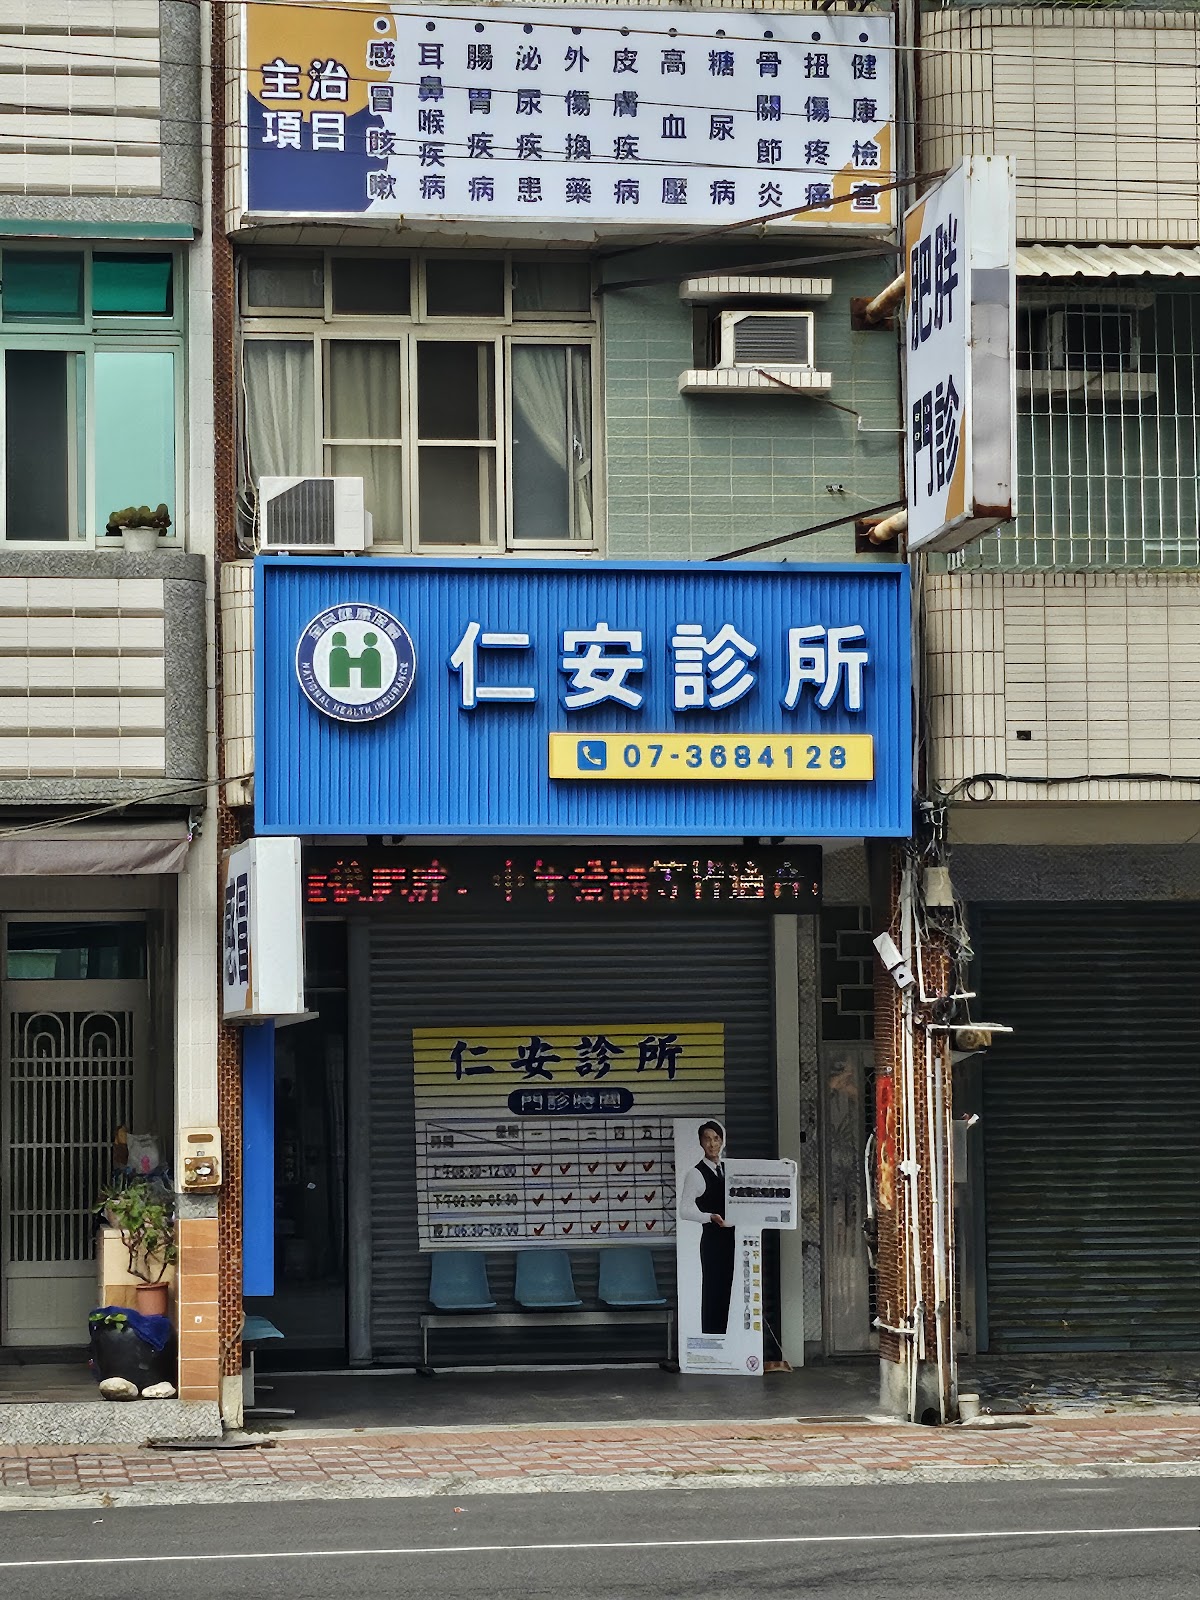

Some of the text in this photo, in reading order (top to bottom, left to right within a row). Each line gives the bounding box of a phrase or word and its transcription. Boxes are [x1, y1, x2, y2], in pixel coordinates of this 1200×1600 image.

[261, 58, 349, 101] 主治
[261, 111, 346, 151] 項目
[369, 41, 397, 200] 感冒咳嗽
[418, 42, 446, 200] 耳鼻喉疾病
[467, 43, 495, 202] 腸胃疾病
[515, 45, 543, 203] 泌尿疾患
[564, 46, 591, 204] 外傷換藥
[613, 47, 640, 205] 皮膚疾病
[660, 49, 688, 205] 高血壓
[708, 49, 736, 206] 糖尿病
[756, 51, 783, 208] 骨關節炎
[804, 52, 832, 209] 扭傷疼痛
[851, 53, 878, 210] 健康檢查
[911, 213, 959, 351] 肥胖
[913, 374, 960, 506] 門診
[332, 703, 373, 717] HEALTH
[450, 621, 869, 709] 仁安診所
[623, 744, 847, 769] 07-3684128
[450, 1034, 684, 1080] 仁安診所
[521, 1091, 621, 1111] 門診時間
